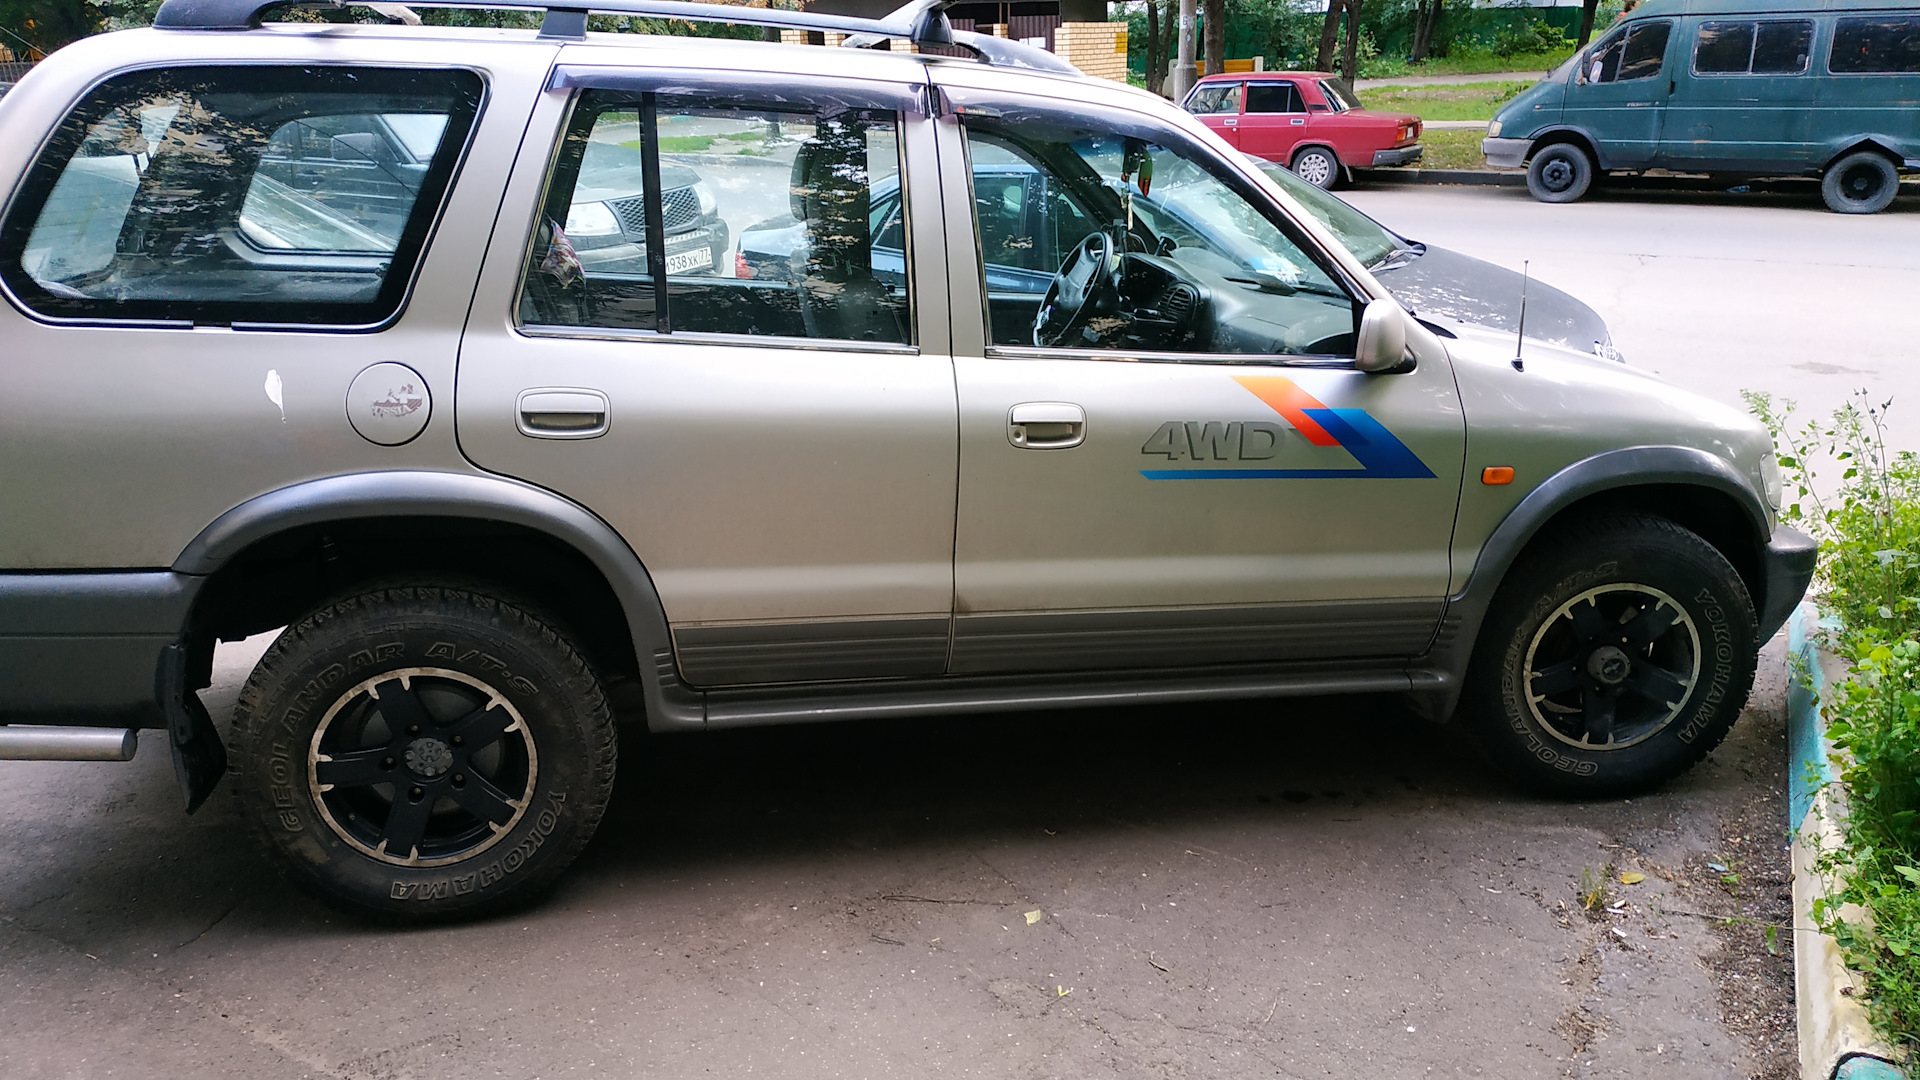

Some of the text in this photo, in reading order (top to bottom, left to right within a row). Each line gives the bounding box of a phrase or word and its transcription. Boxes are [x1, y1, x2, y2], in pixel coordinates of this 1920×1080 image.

[371, 404, 411, 416] USSIA
[1141, 421, 1286, 460] 4WD
[1502, 627, 1599, 777] GEOLANDAR
[1677, 587, 1733, 745] YOKOHAMA
[268, 641, 406, 833] GEOLANDAR
[390, 790, 567, 901] YOKOHAMA
